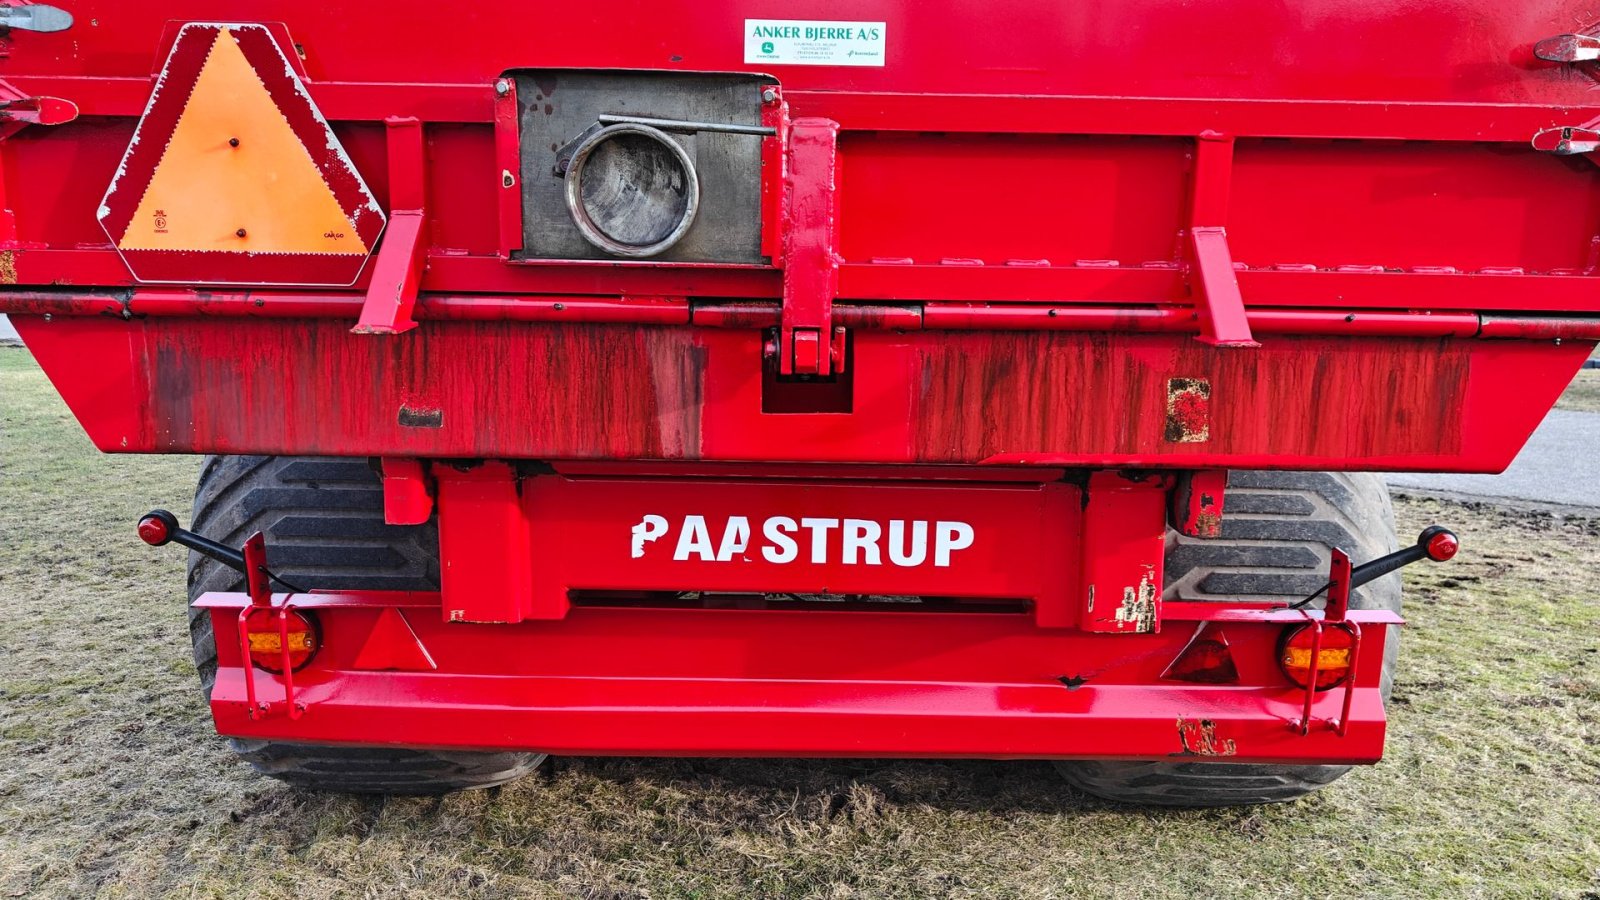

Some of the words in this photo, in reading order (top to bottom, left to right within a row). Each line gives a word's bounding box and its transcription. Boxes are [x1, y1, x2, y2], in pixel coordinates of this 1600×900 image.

[753, 26, 800, 38] ANKER
[805, 27, 853, 41] BJERRE
[857, 28, 879, 41] A/S
[631, 514, 974, 567] PAASTRUP
